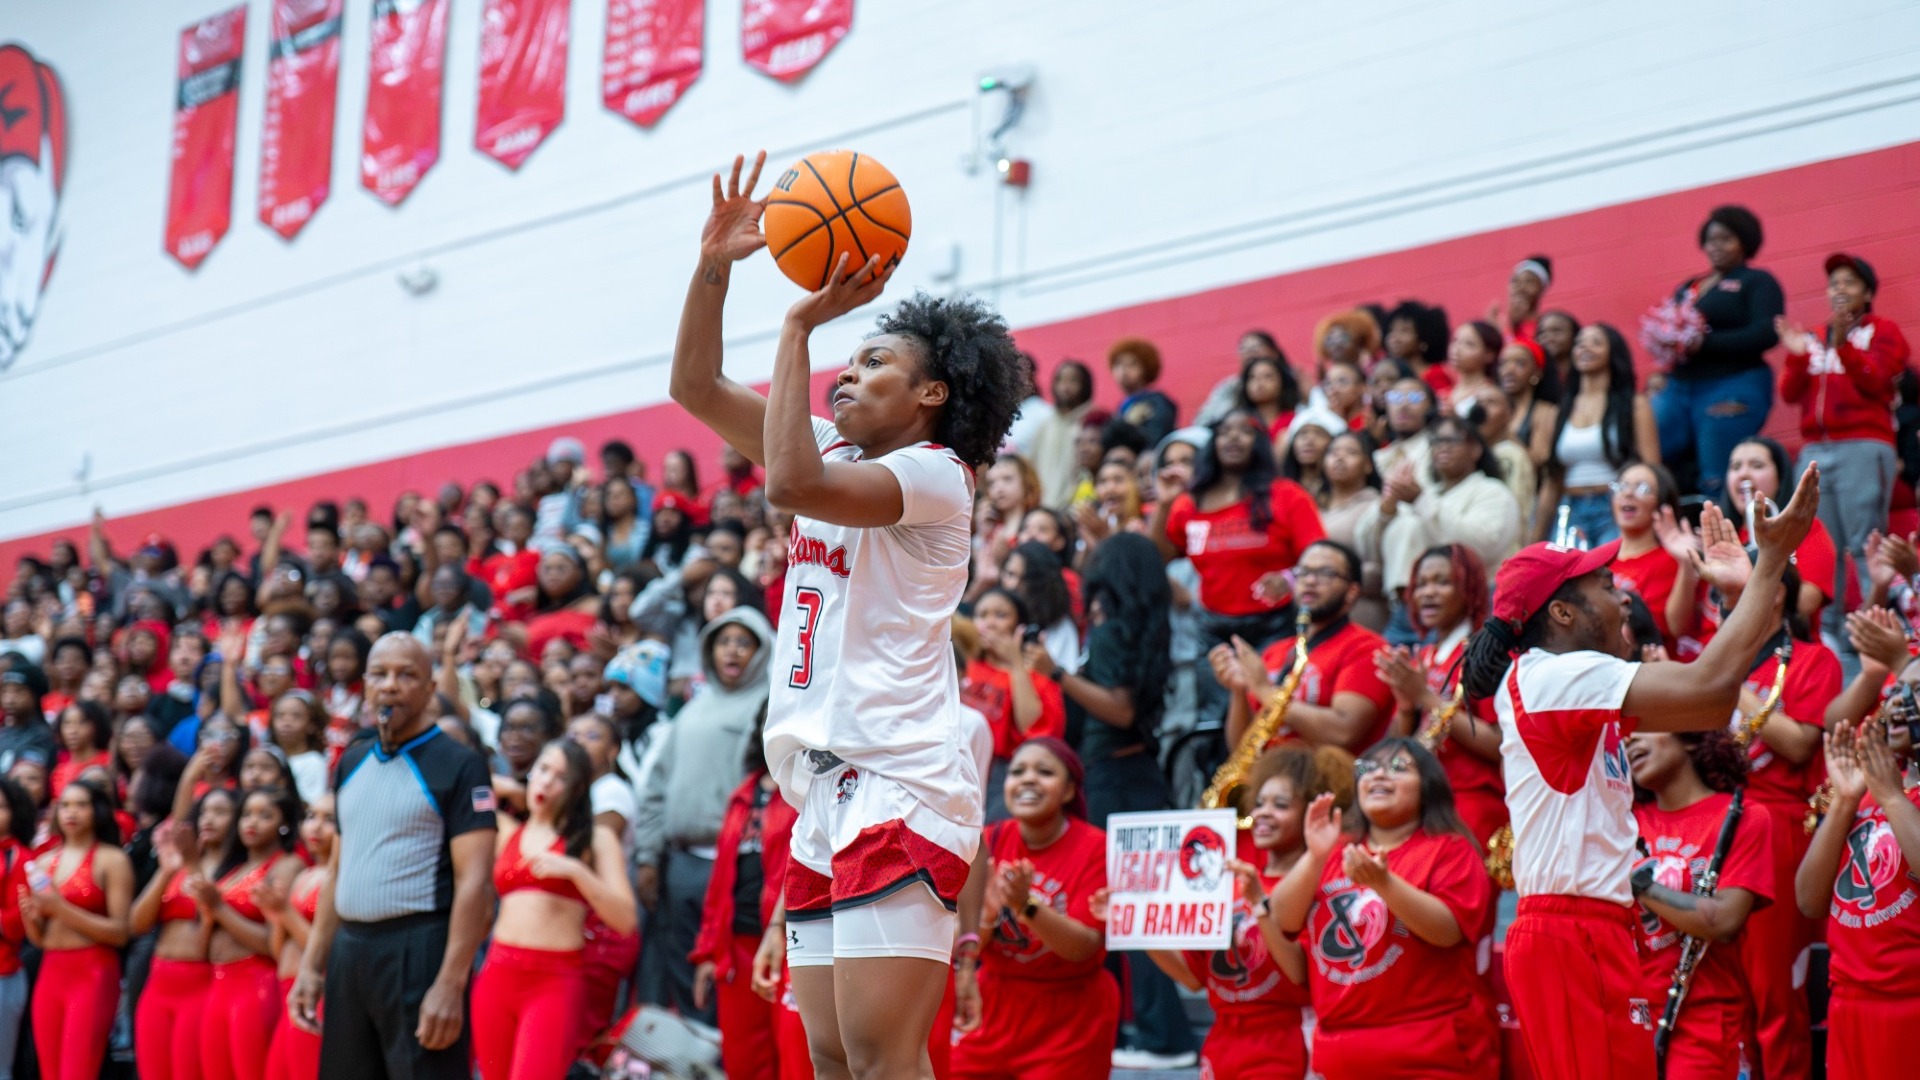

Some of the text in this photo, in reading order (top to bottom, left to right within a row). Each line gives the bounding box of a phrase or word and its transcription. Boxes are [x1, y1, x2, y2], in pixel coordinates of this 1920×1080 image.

[789, 586, 824, 690] 3
[1116, 825, 1181, 851] PROTECT THE
[1110, 850, 1180, 893] LEGACY
[1111, 903, 1226, 936] GO RAMS!
